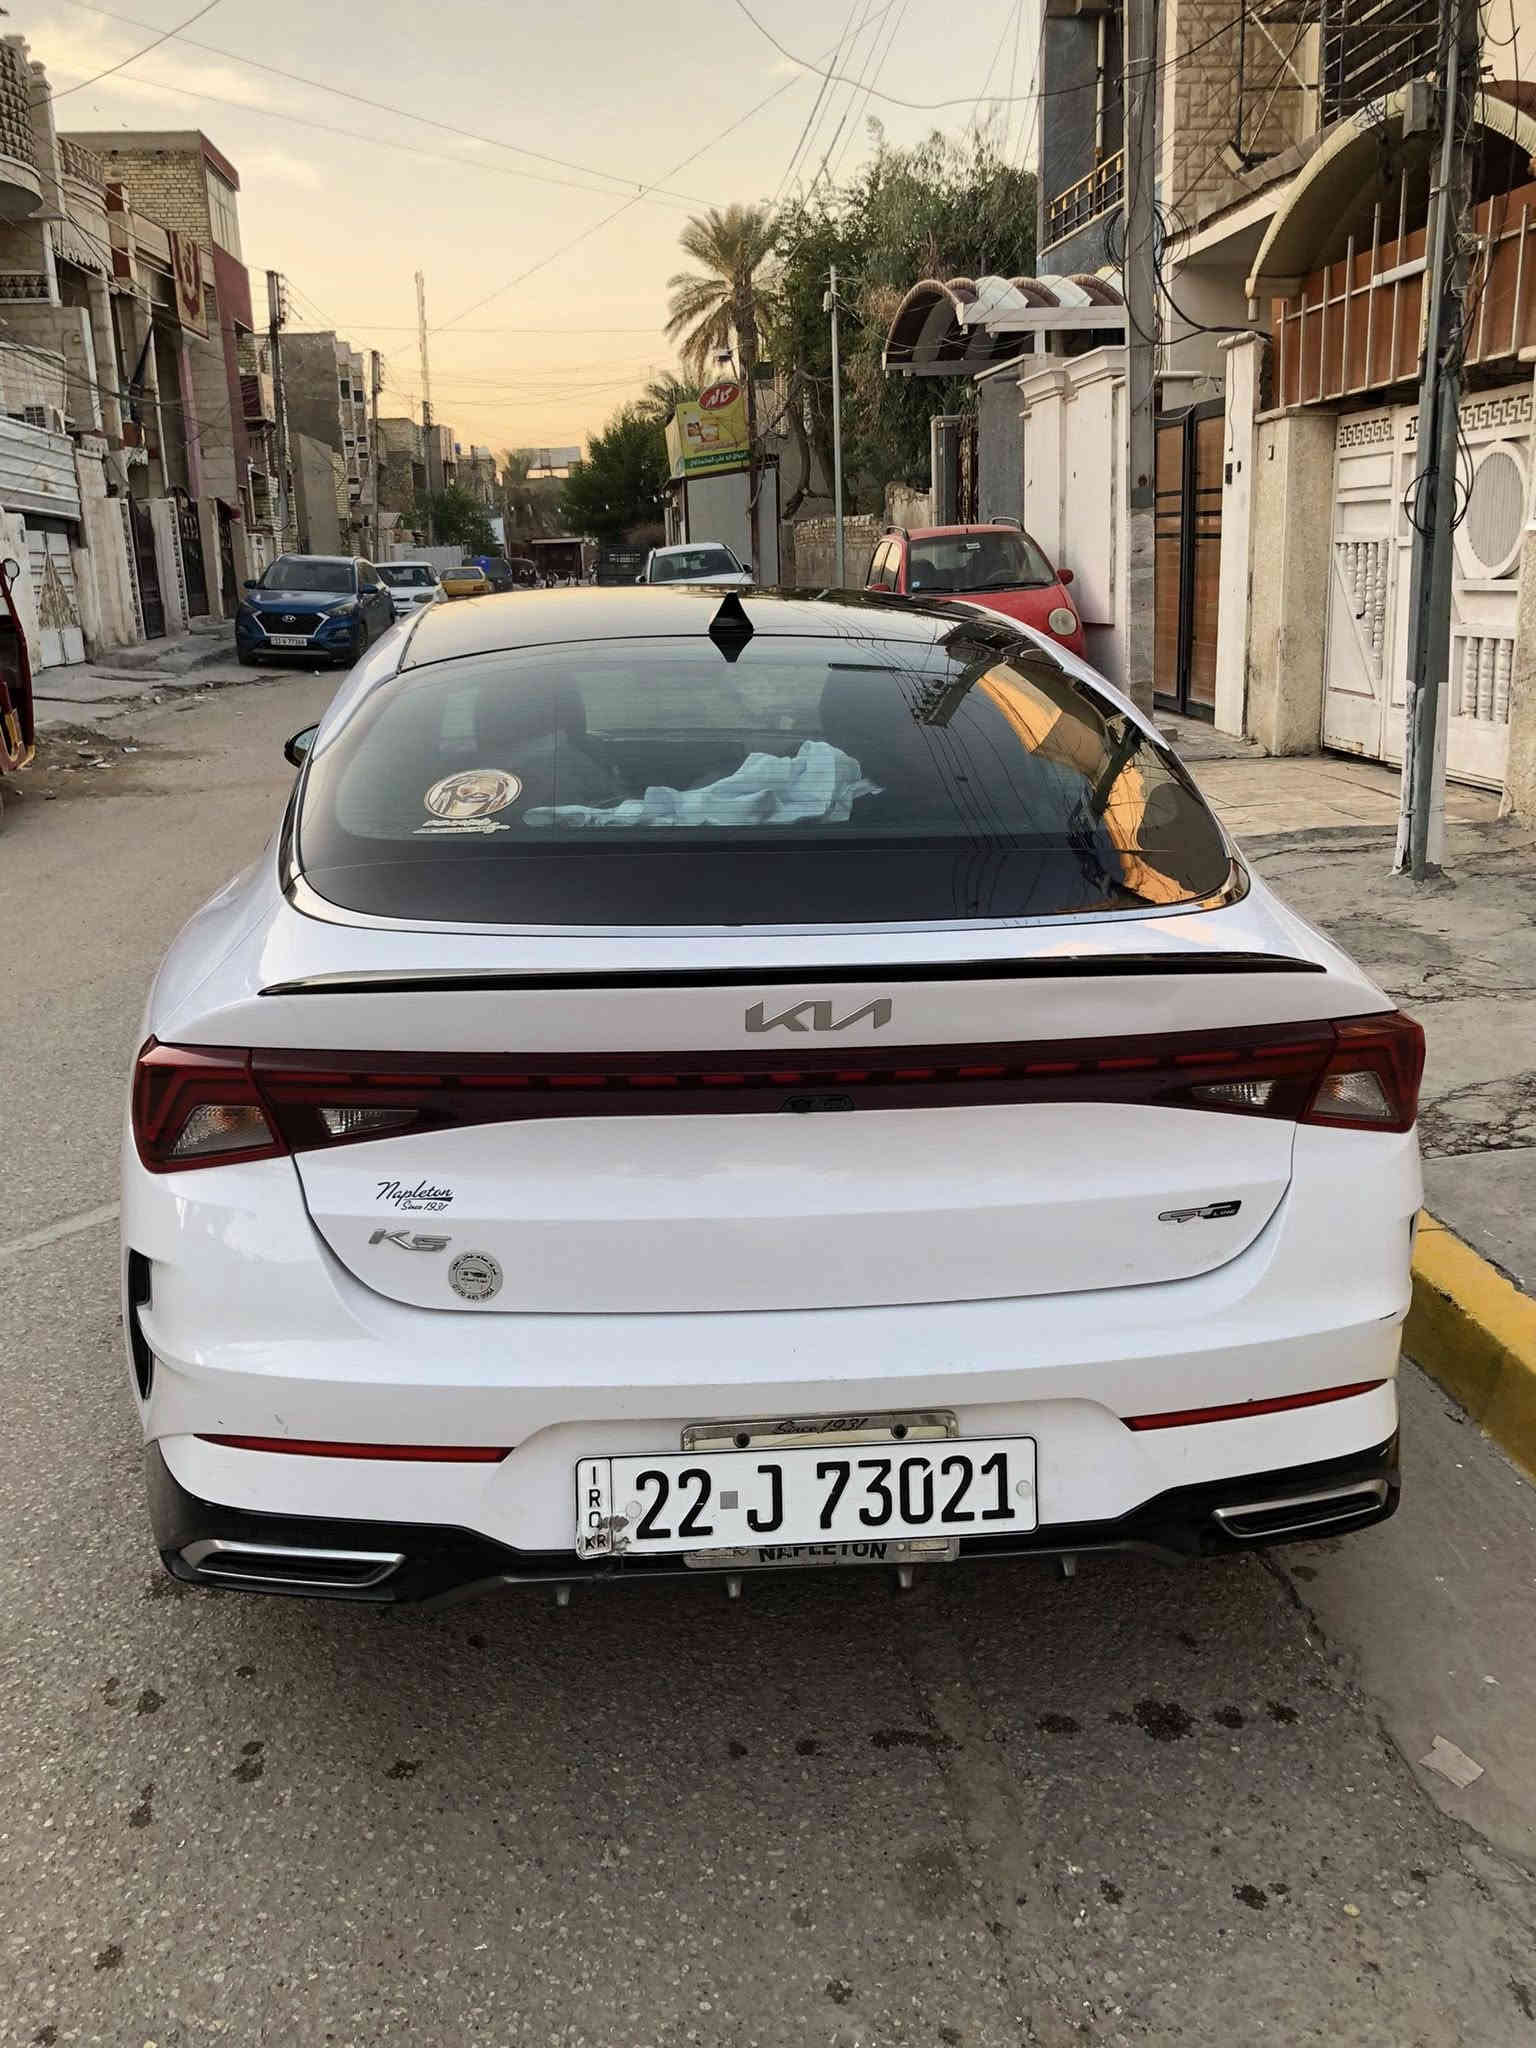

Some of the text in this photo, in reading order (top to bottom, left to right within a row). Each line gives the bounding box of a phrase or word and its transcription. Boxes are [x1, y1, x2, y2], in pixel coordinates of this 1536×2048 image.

[745, 998, 892, 1033] KIA
[376, 1180, 454, 1207] Napleton
[423, 1201, 449, 1211] 1931
[368, 1228, 452, 1252] K5
[775, 1417, 869, 1435] Since 1931
[636, 1452, 1016, 1540] 22 J 73021
